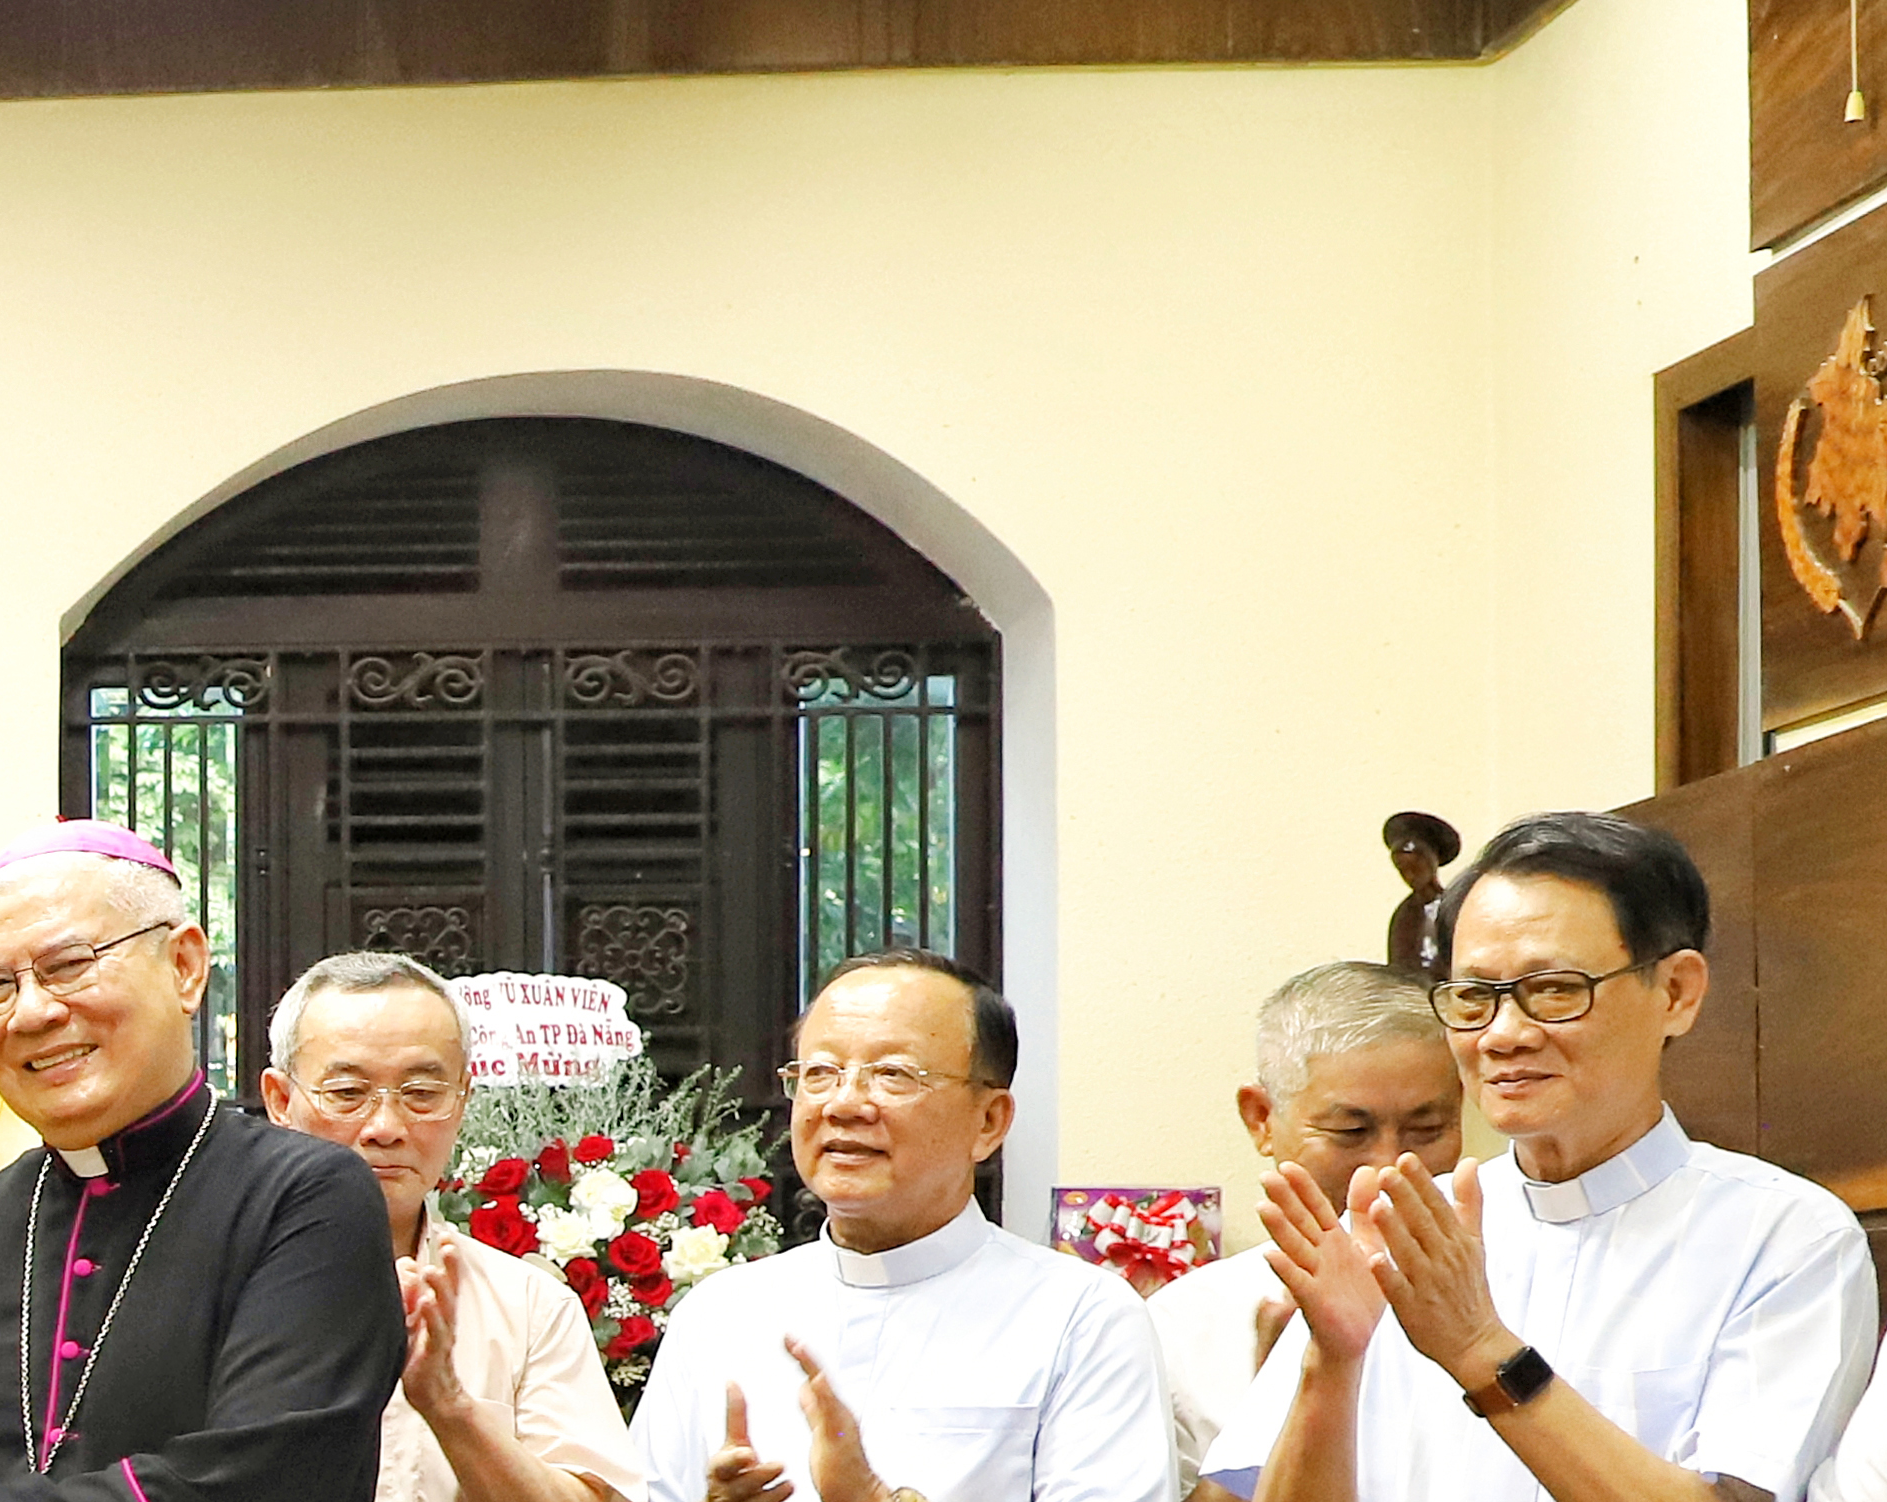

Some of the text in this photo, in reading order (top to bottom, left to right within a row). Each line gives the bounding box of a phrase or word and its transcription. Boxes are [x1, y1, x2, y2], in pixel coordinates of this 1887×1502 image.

[519, 978, 566, 1007] XUÂN
[570, 983, 612, 1014] VIÊN
[539, 1023, 562, 1045] TP
[565, 1022, 588, 1045] Đà
[590, 1018, 635, 1053] Nẵng
[470, 1053, 507, 1077] úc
